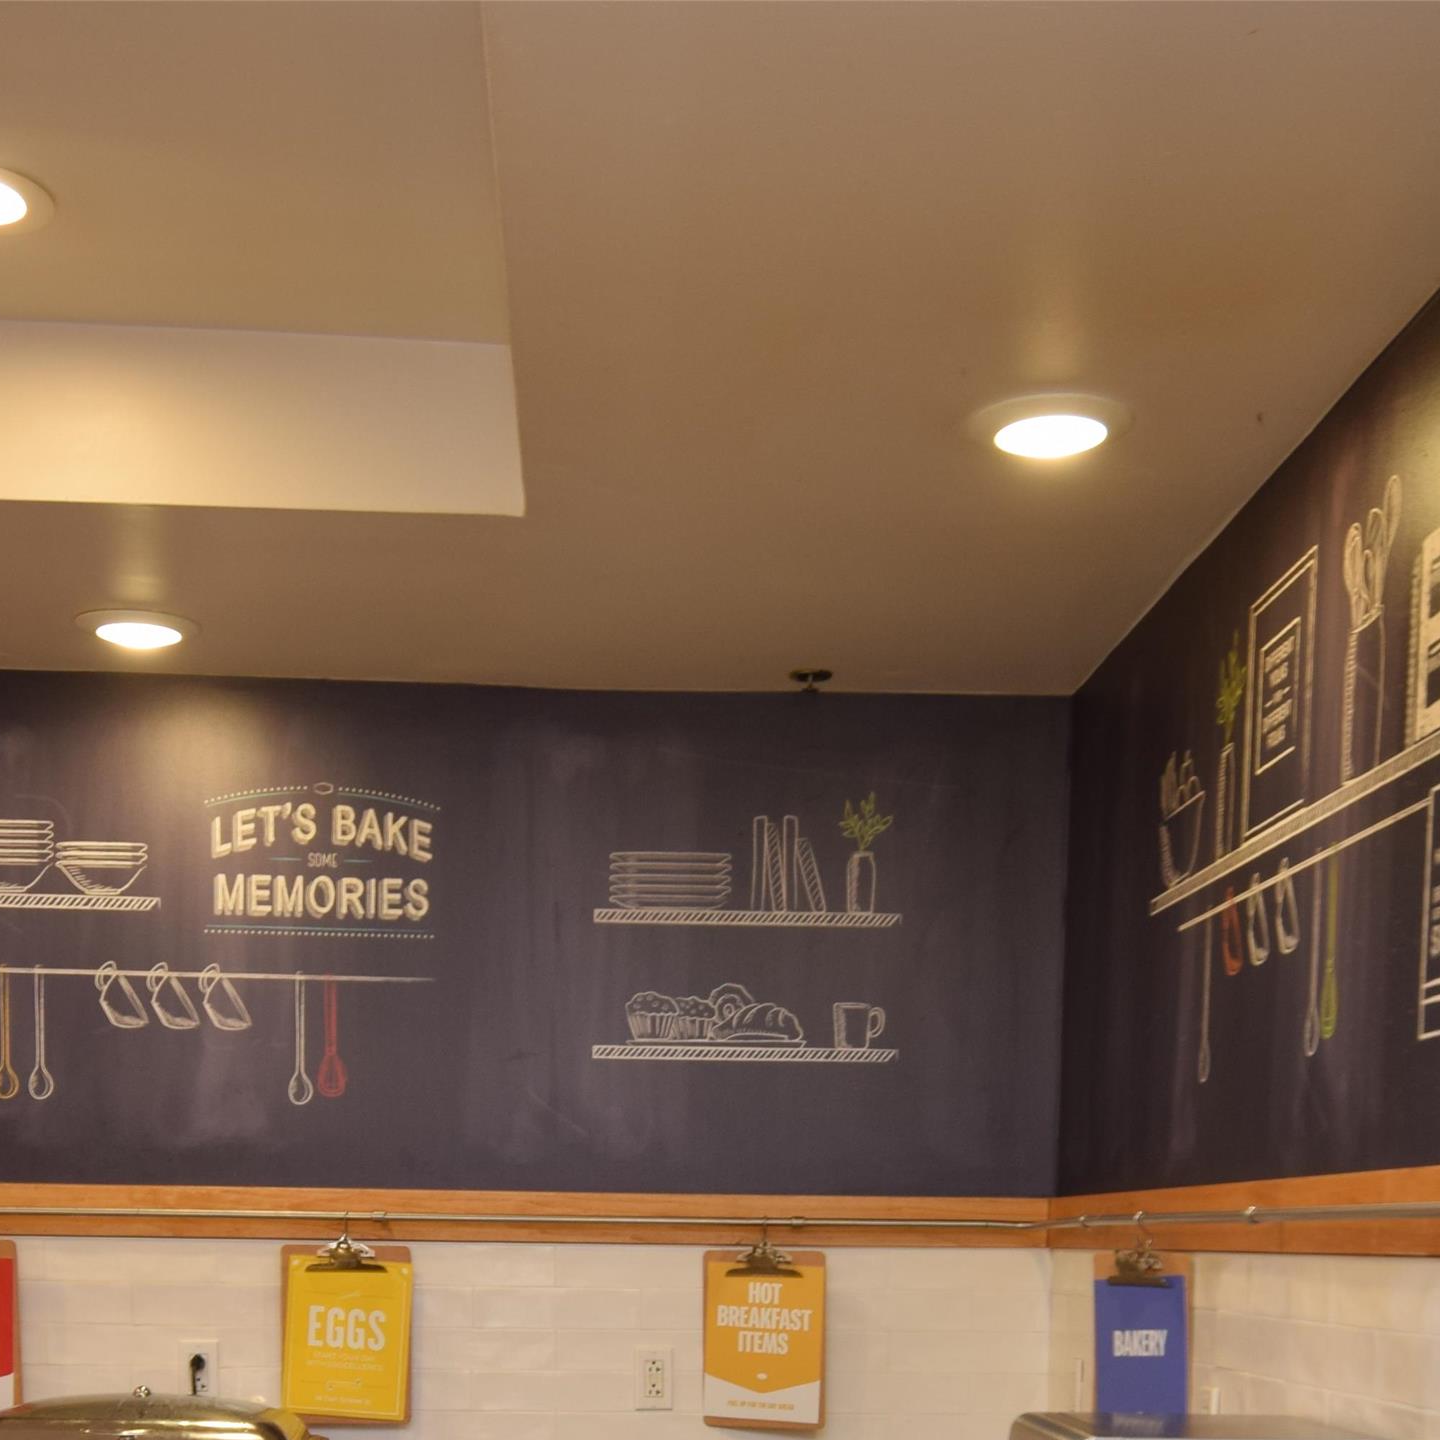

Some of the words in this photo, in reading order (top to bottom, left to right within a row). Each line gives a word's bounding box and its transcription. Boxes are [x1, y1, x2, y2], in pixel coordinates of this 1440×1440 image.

[211, 802, 317, 859] LET'S
[331, 804, 433, 862] BAKE
[307, 852, 339, 868] SOME
[213, 873, 430, 921] MEMORIES
[748, 1281, 783, 1305] HOT
[307, 1305, 386, 1351] EGGS
[717, 1305, 813, 1331] BREAKFAST
[738, 1331, 789, 1356] ITEMS
[1113, 1329, 1168, 1357] BAKERY
